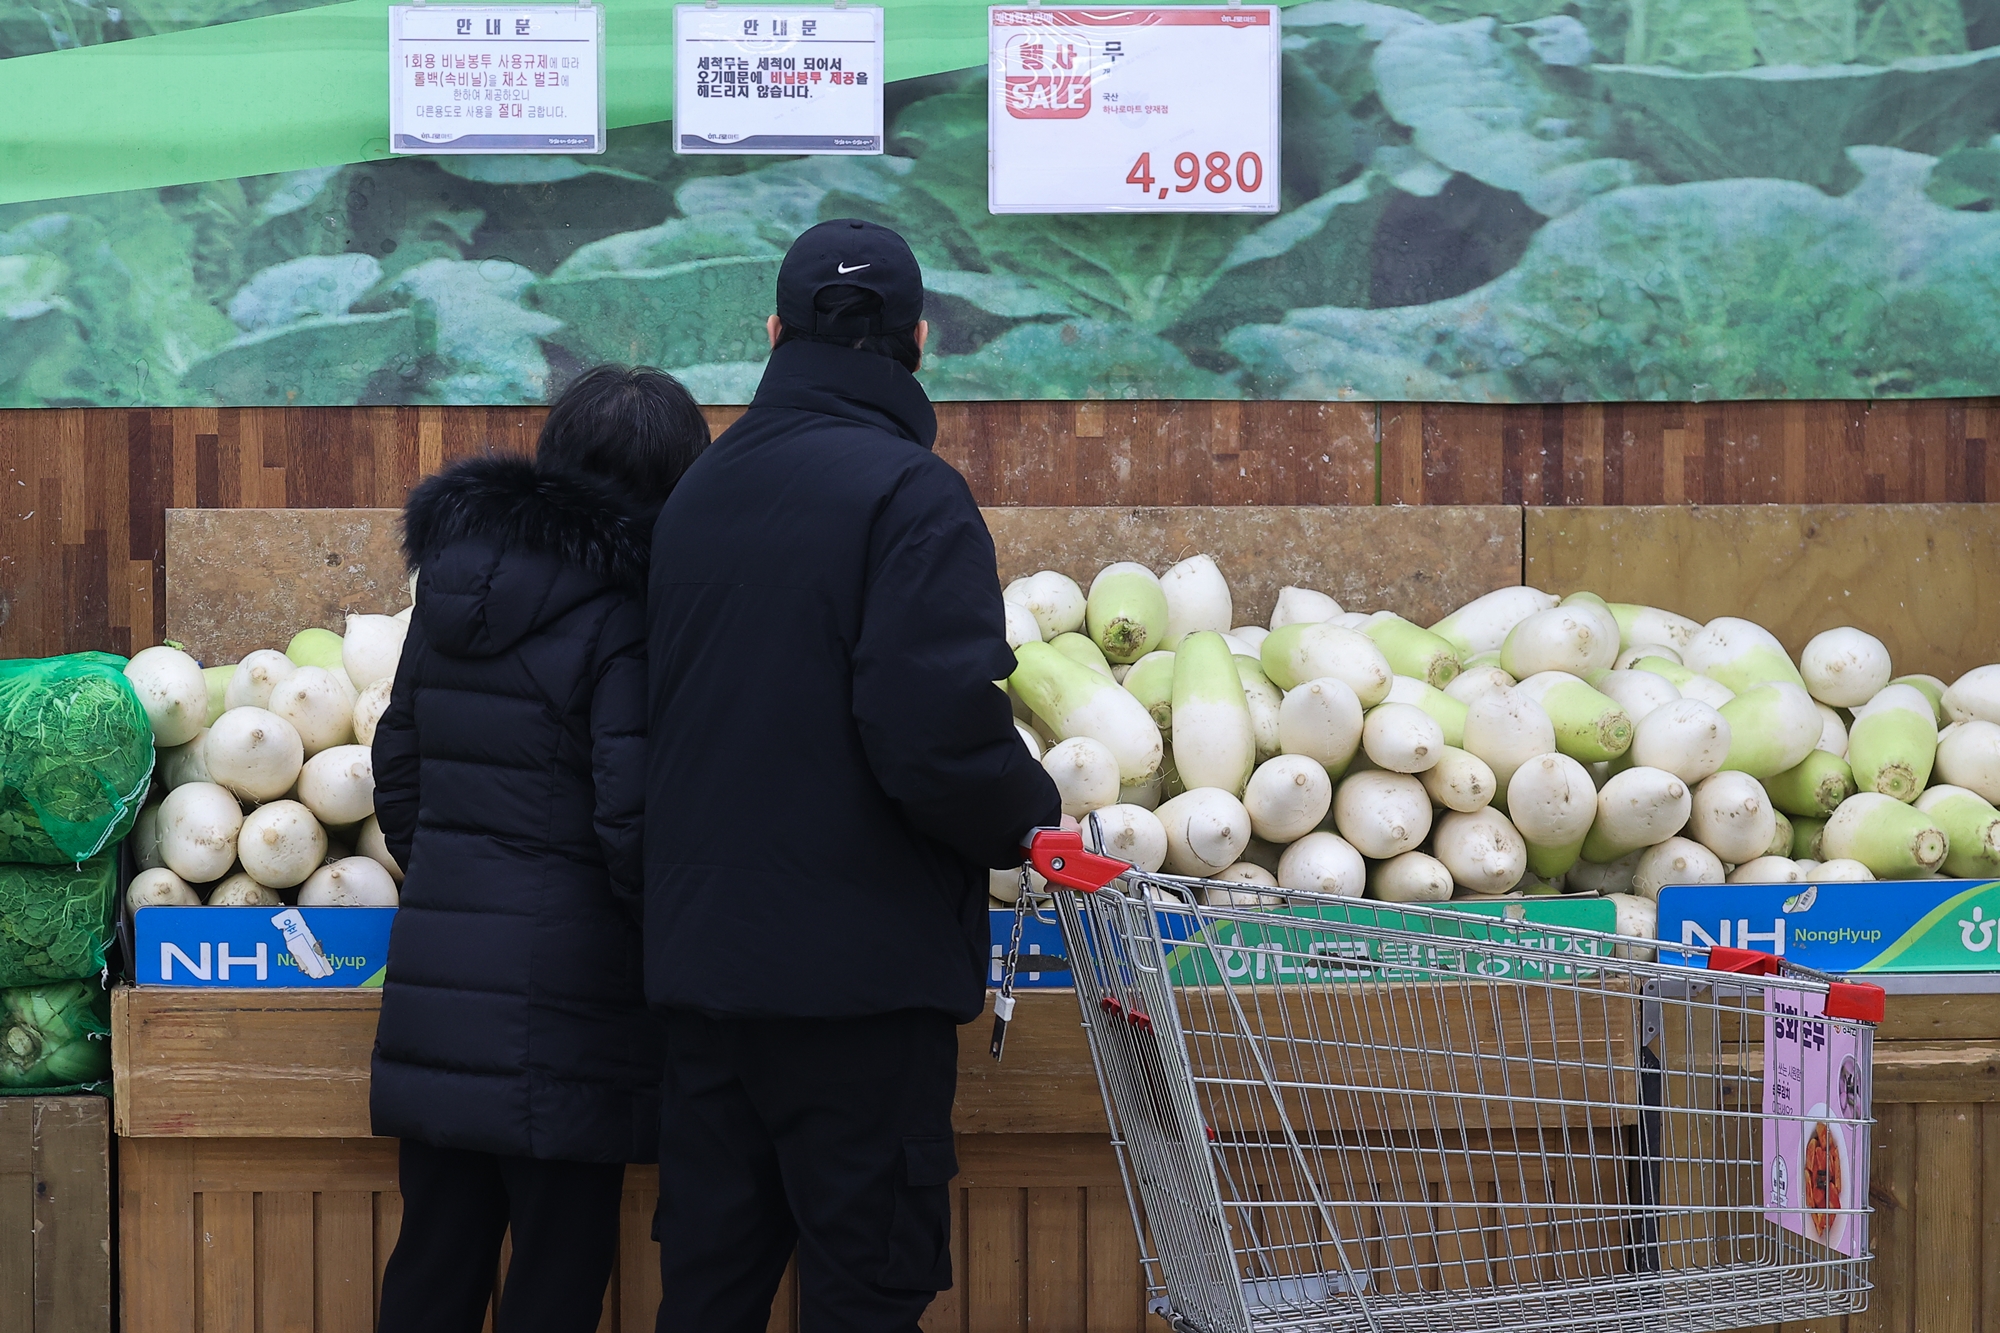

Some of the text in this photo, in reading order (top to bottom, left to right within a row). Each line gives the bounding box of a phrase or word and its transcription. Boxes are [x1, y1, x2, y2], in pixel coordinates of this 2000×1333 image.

[1102, 41, 1125, 63] 무
[404, 53, 580, 70] 1회용 비닐봉투 사용규제에 따라
[697, 56, 842, 71] 세척무는 세척이 되어서
[414, 70, 570, 88] 롤백(속비닐)을 채소 벌크에
[697, 70, 763, 85] 오기때문에
[829, 71, 869, 86] 제공을
[453, 88, 530, 102] 한하여 제공하오니
[697, 84, 813, 99] 해드리지 않습니다.
[1011, 84, 1086, 111] SALE
[1102, 92, 1120, 103] 국산
[416, 102, 567, 119] 다른용도로 사용을 절대 금합니다.
[1103, 104, 1170, 115] 하나로마트 양재점
[1125, 150, 1263, 200] 4,980
[1681, 917, 1786, 957] NH
[1794, 927, 1882, 944] NongHyup
[160, 942, 268, 981] NH
[277, 952, 367, 968] NoHyup
